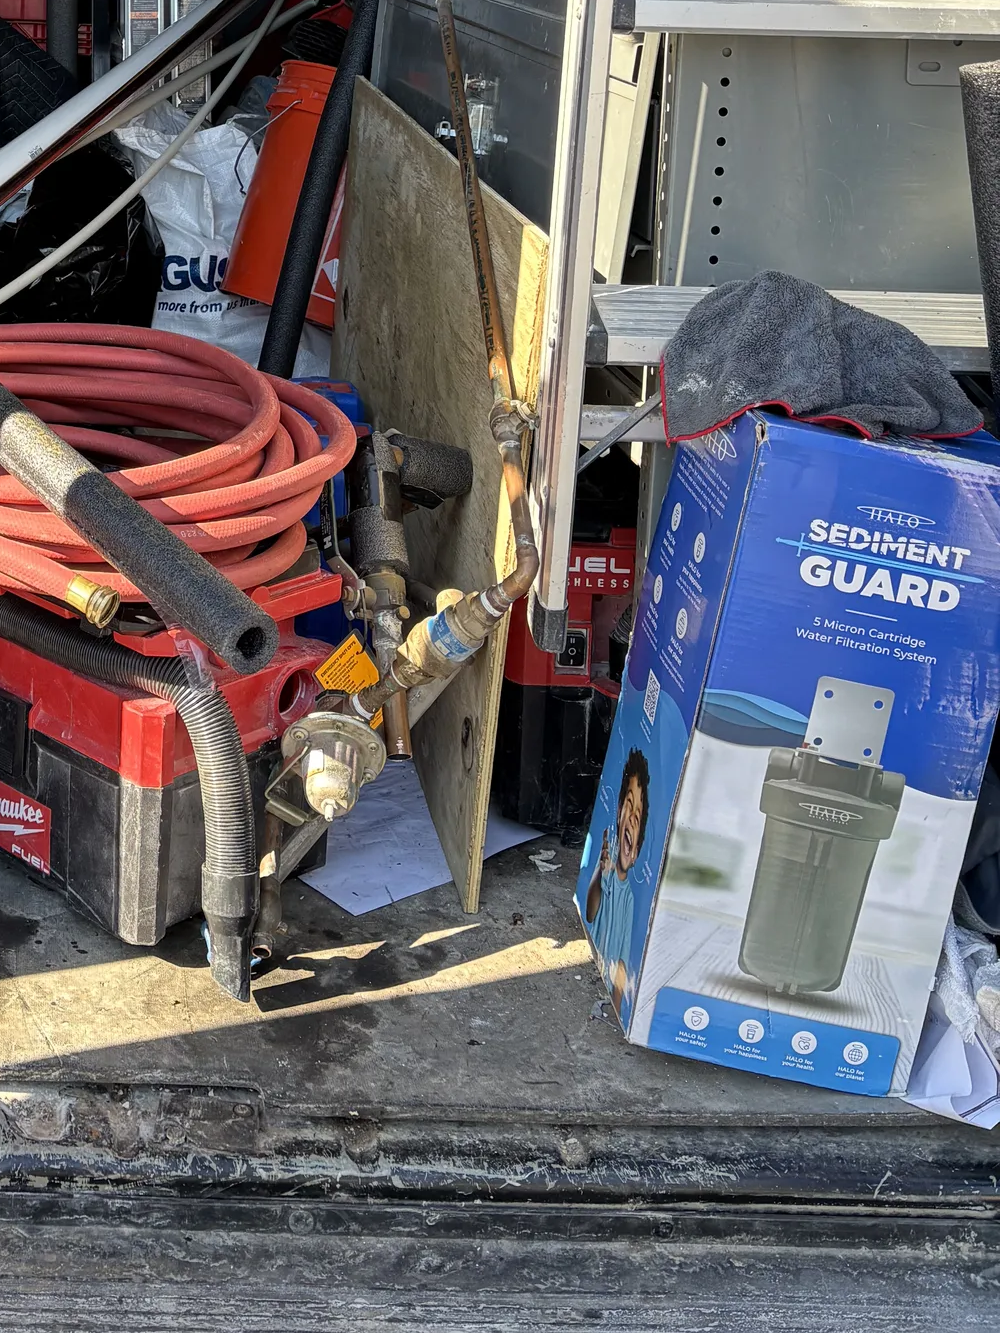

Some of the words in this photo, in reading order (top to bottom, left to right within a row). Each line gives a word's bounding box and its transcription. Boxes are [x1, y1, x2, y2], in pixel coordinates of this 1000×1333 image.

[157, 301, 187, 313] more
[189, 300, 223, 313] from
[869, 508, 920, 528] HALO
[808, 518, 971, 570] SEDIMENT
[569, 556, 631, 574] UEL
[799, 555, 961, 612] GUARD
[812, 616, 821, 627] 5
[823, 618, 866, 636] Micron
[868, 628, 926, 649] Cartridge
[795, 627, 833, 644] Water
[835, 636, 891, 656] Filtration
[893, 647, 938, 665] System
[809, 805, 850, 822] HALO
[11, 844, 51, 875] FUEL
[675, 1036, 689, 1044] your
[689, 1038, 708, 1049] safety
[679, 1031, 697, 1040] HALO
[697, 1033, 707, 1042] for
[724, 1047, 738, 1055] your
[738, 1050, 768, 1061] happiness
[733, 1043, 751, 1052] HALO
[752, 1046, 761, 1054] for
[785, 1054, 804, 1063] HALO
[804, 1058, 814, 1066] for
[796, 1062, 815, 1071] health
[837, 1066, 855, 1075] HALO
[855, 1068, 865, 1076] for
[846, 1072, 865, 1082] planet
